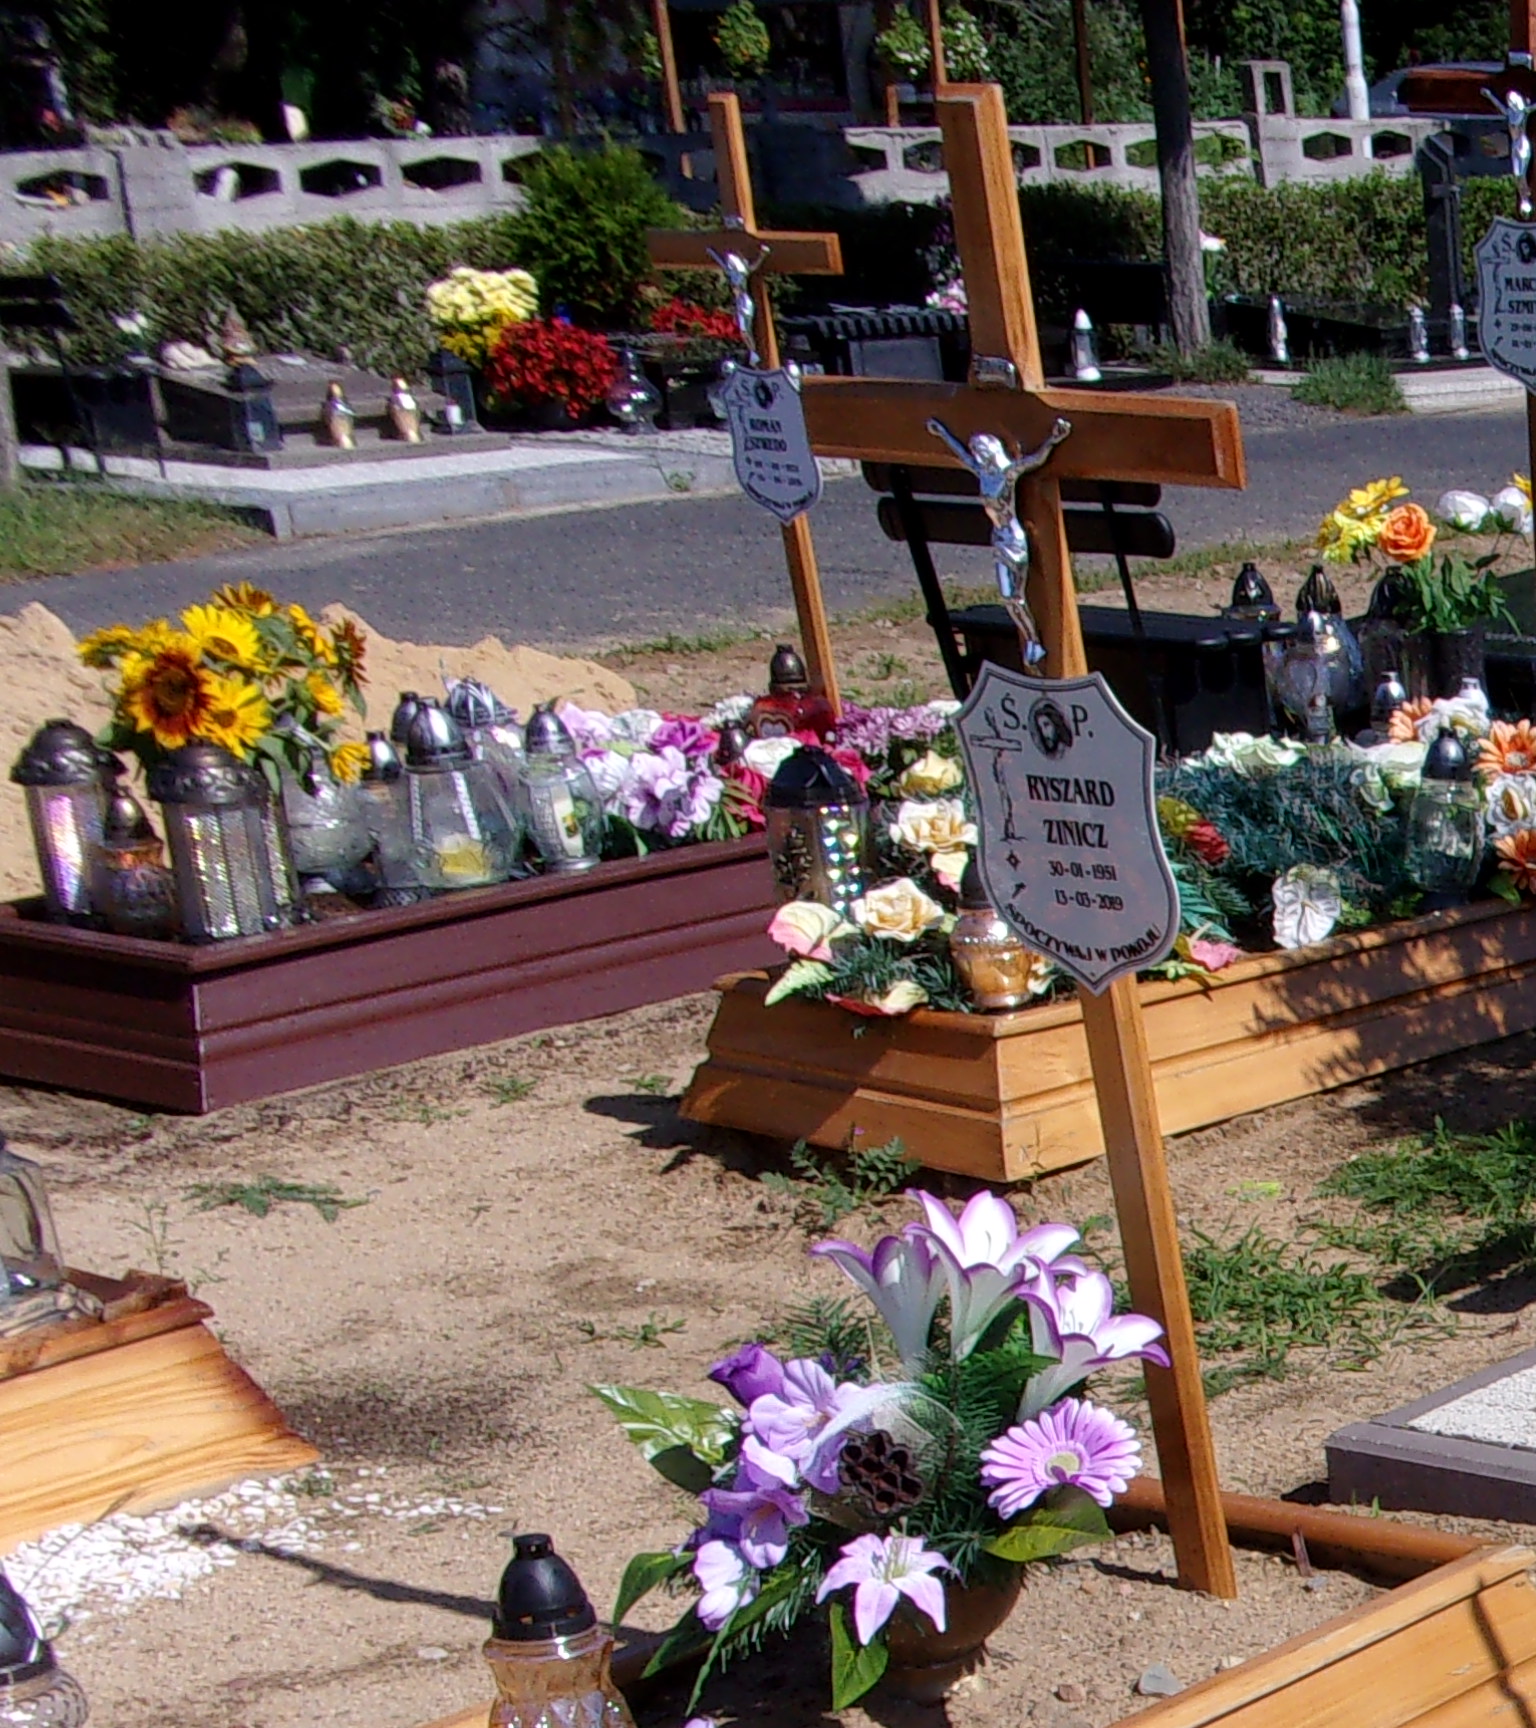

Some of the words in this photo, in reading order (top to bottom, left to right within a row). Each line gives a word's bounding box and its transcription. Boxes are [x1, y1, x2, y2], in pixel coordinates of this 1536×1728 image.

[1000, 692, 1027, 731] Ś.
[1071, 704, 1094, 738] P.
[1025, 773, 1115, 808] RYSZARD
[1042, 818, 1109, 849] ZINICZ
